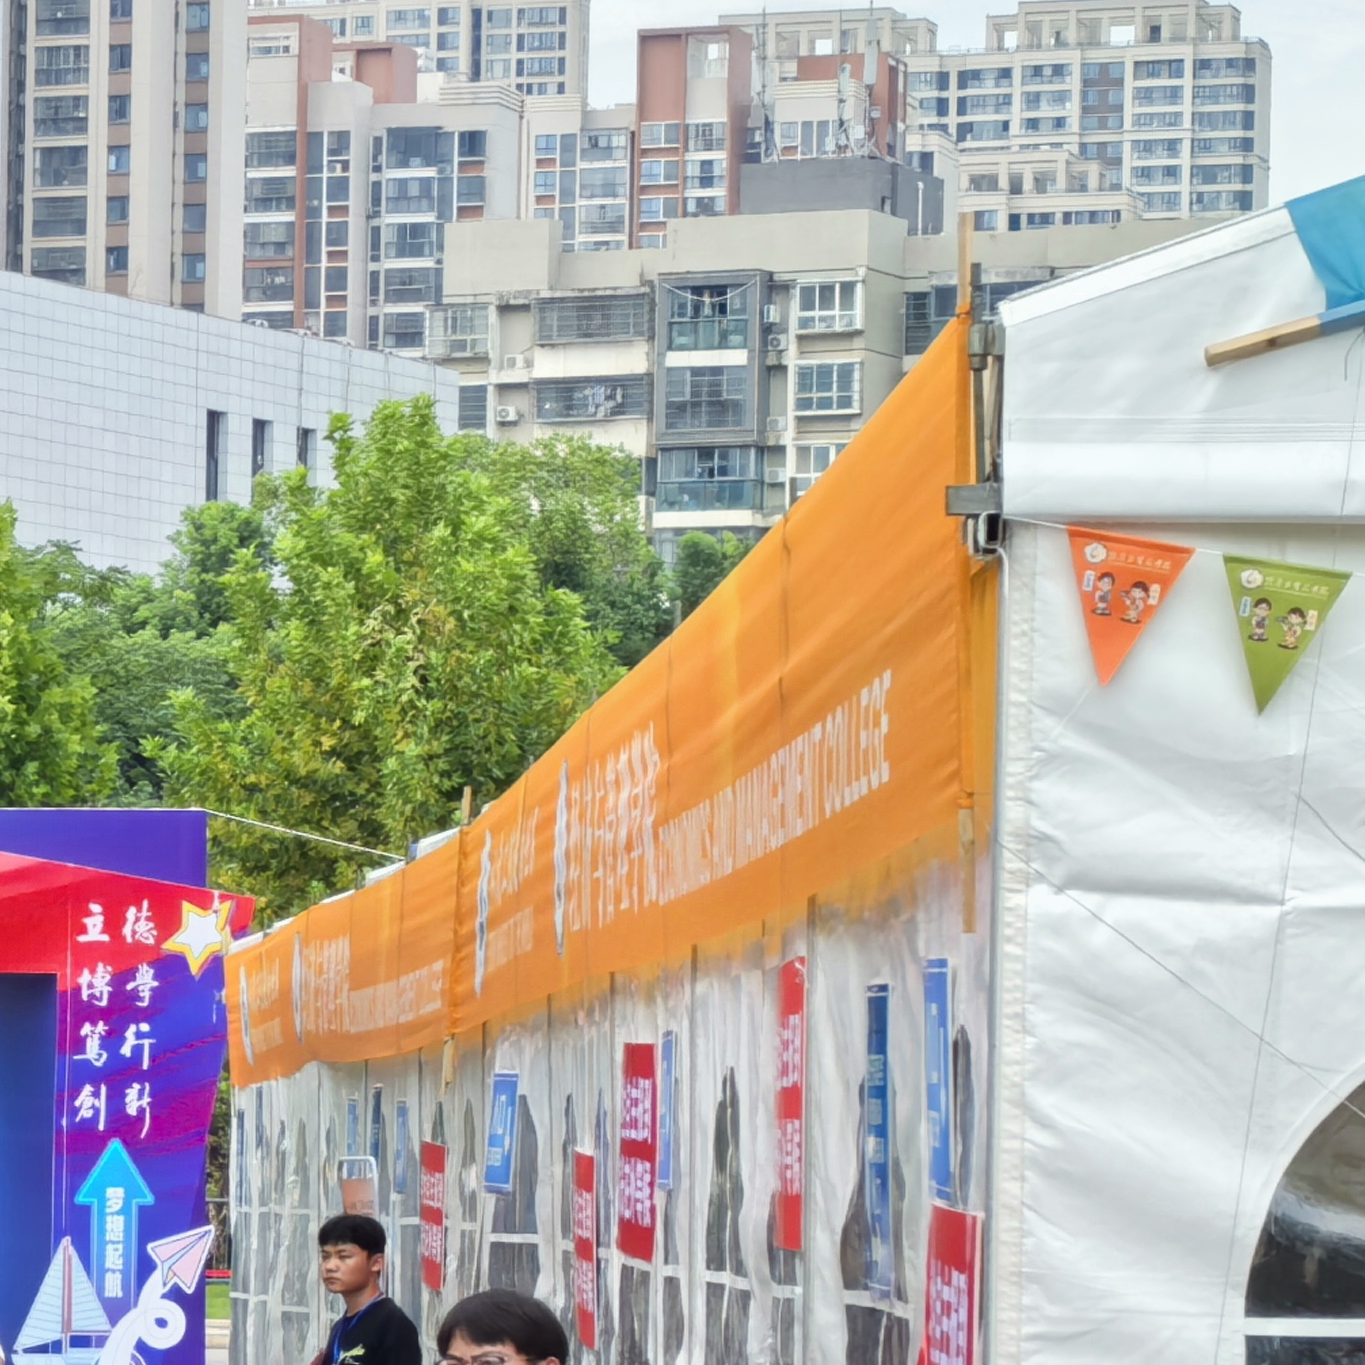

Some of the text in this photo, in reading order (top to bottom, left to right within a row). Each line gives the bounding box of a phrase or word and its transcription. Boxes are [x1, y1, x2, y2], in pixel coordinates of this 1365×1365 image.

[823, 668, 892, 820] COLLEGE
[76, 899, 158, 945] 立德
[104, 1187, 125, 1298] 梦想起航
